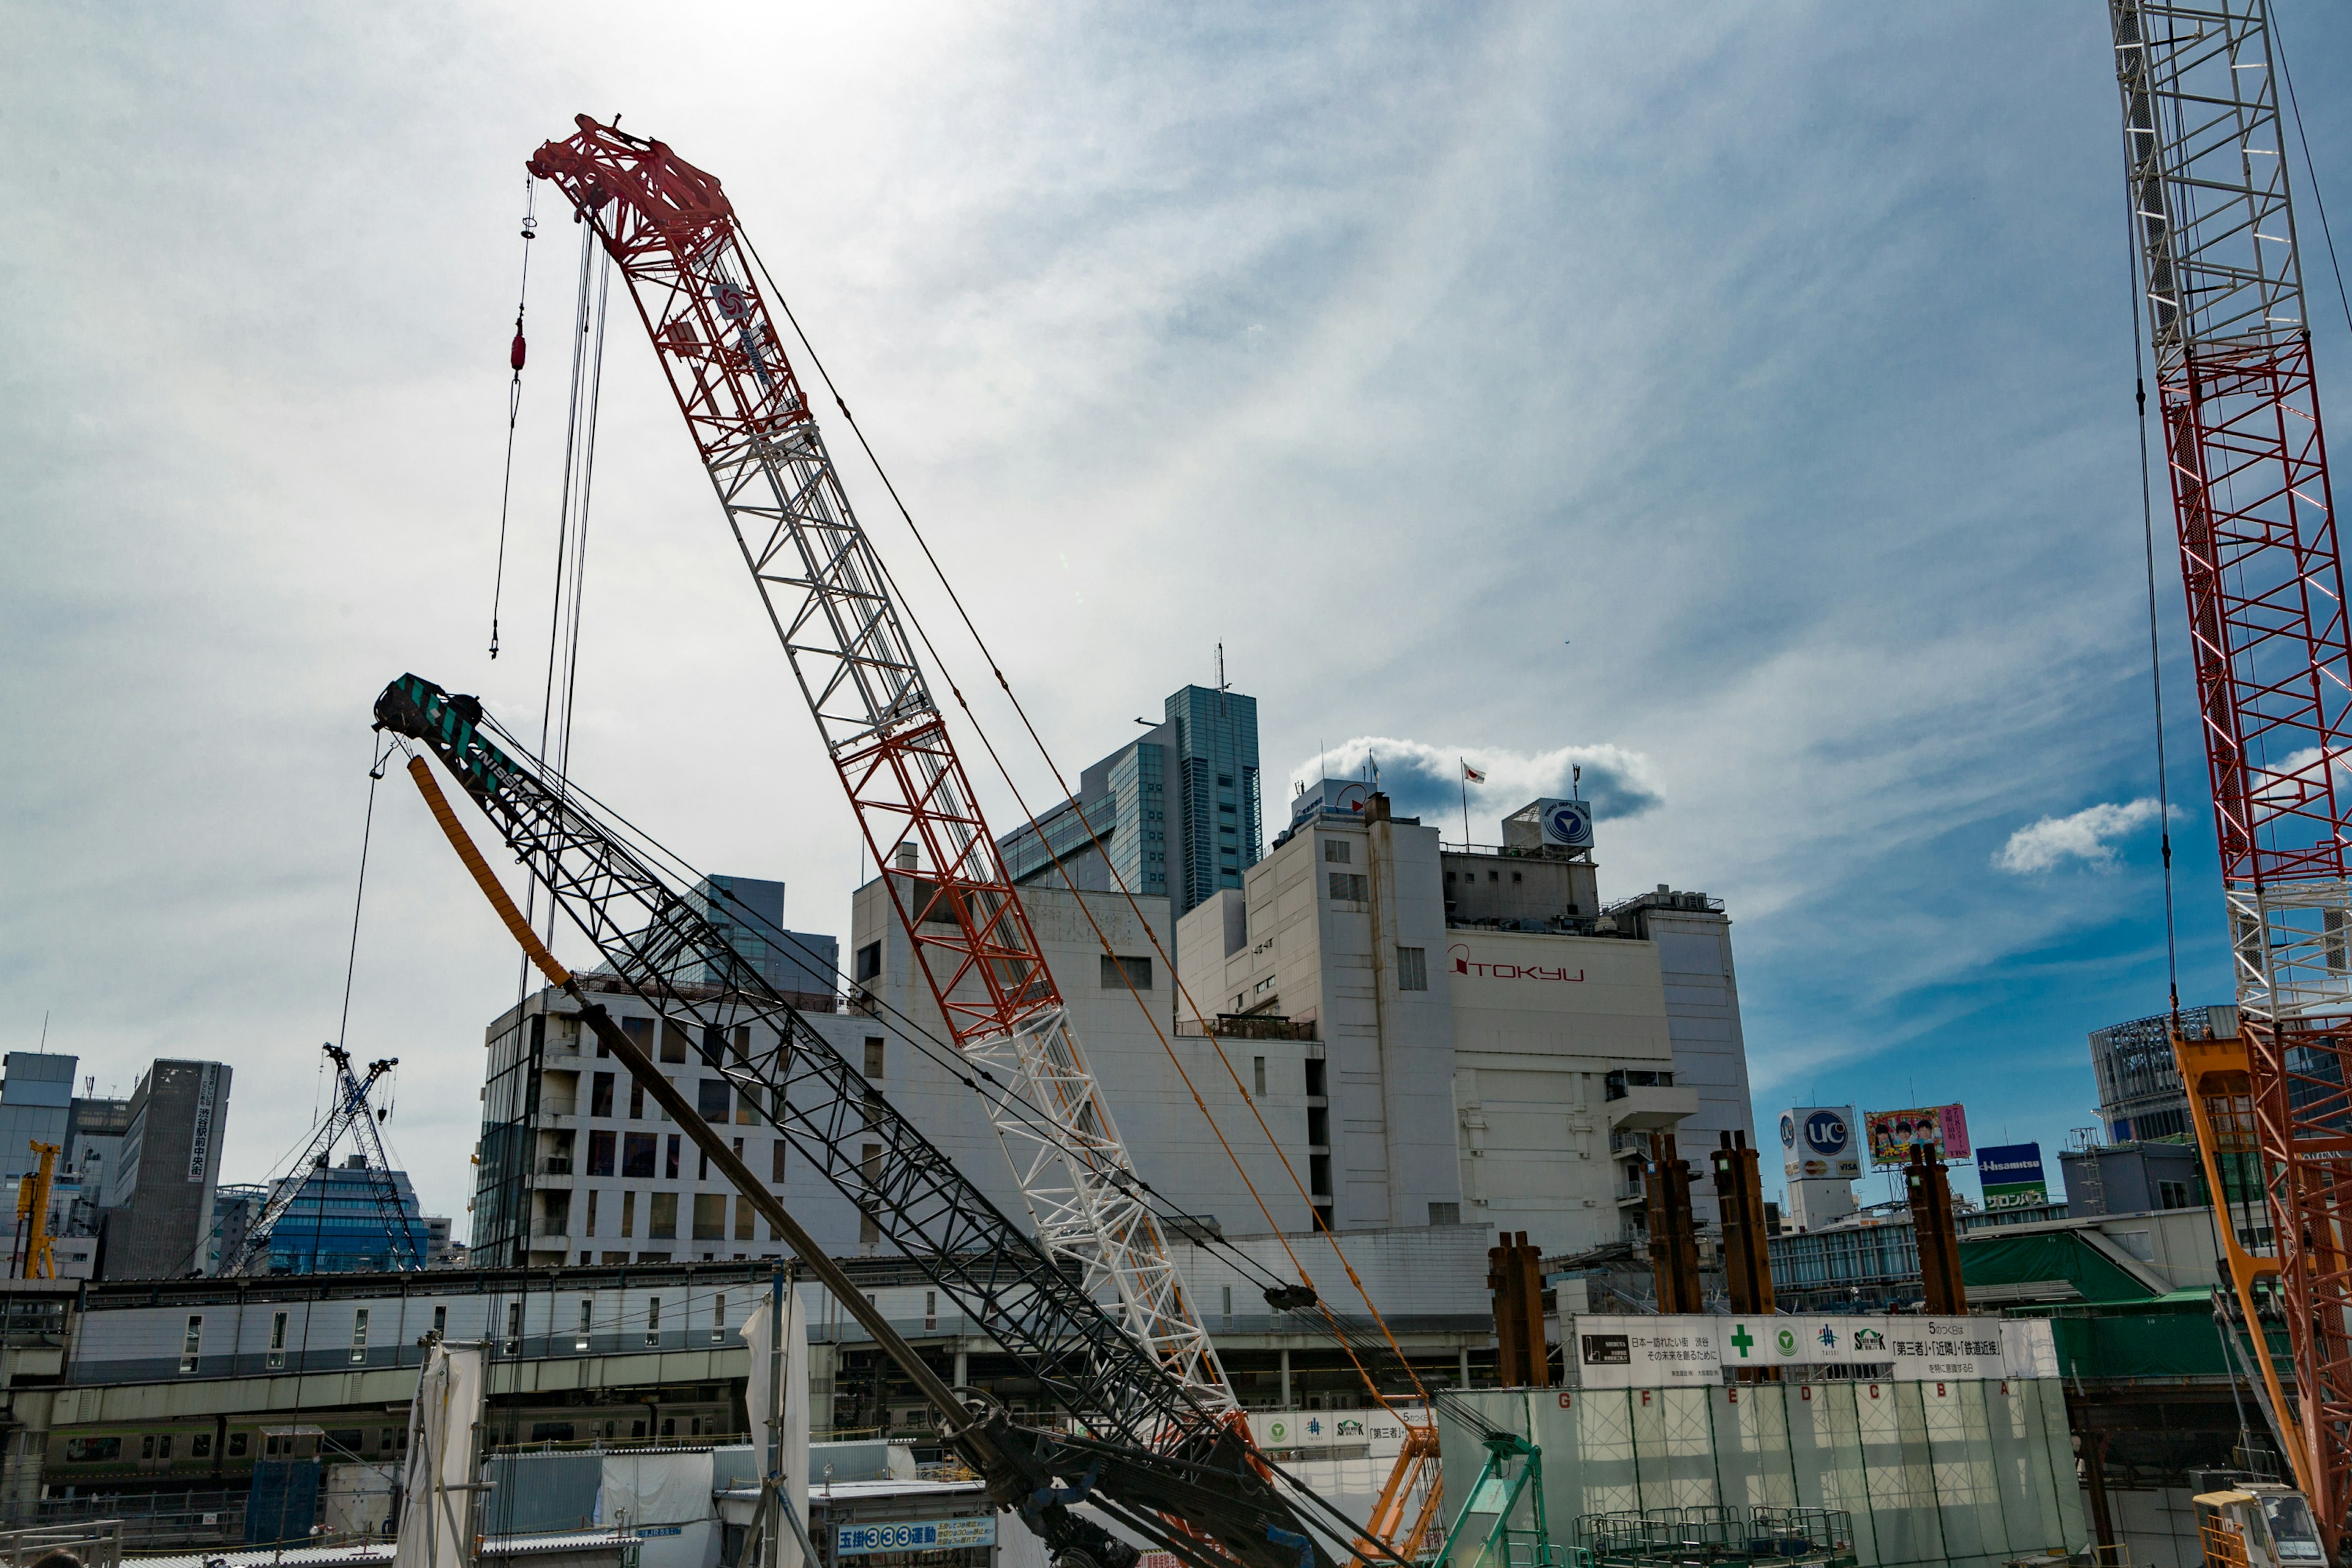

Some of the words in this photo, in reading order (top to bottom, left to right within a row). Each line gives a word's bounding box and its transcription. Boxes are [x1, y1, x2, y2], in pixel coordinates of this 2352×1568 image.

[742, 332, 767, 382] UCHIMIYA
[478, 752, 534, 808] NISSHA
[1469, 963, 1584, 982] TOKYU
[191, 1108, 209, 1175] 渋谷駅前中央街
[1979, 1160, 2040, 1172] Hisamitsu
[1929, 1322, 1964, 1335] 5のつく日は
[1632, 1337, 1689, 1348] 日本一訪れたい街
[1695, 1337, 1709, 1348] 渋谷
[1648, 1351, 1717, 1361] その未来を創るために
[1929, 1363, 1973, 1373] を特に意識する日
[1801, 1386, 1811, 1401] D
[1869, 1384, 1879, 1398] C
[1937, 1383, 1946, 1397] B
[2000, 1381, 2009, 1395] A
[1559, 1392, 1570, 1408] G
[1642, 1390, 1651, 1406] F
[1728, 1388, 1738, 1403] E
